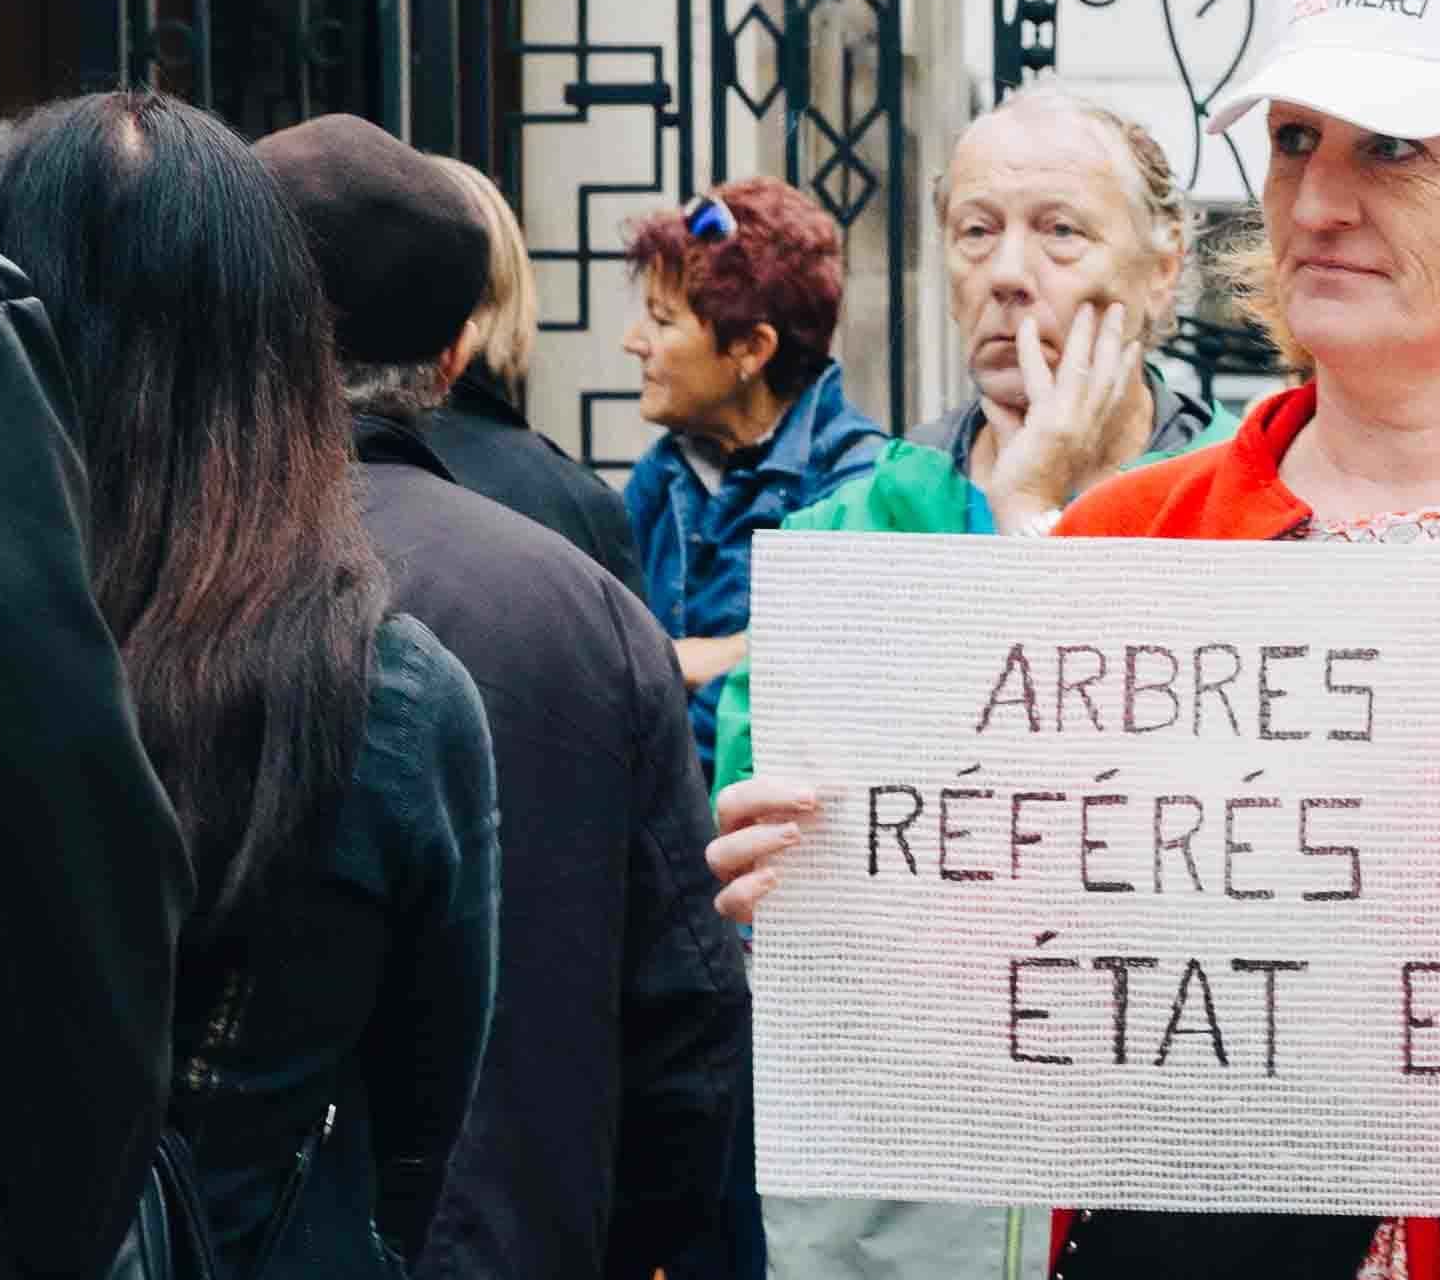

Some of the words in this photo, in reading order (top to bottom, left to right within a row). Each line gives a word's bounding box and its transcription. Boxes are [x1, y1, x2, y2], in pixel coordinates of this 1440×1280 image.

[975, 643, 1380, 741] ARBRES
[867, 764, 1363, 902] RÉFÉRÉS
[1009, 930, 1310, 1077] ÉTAT
